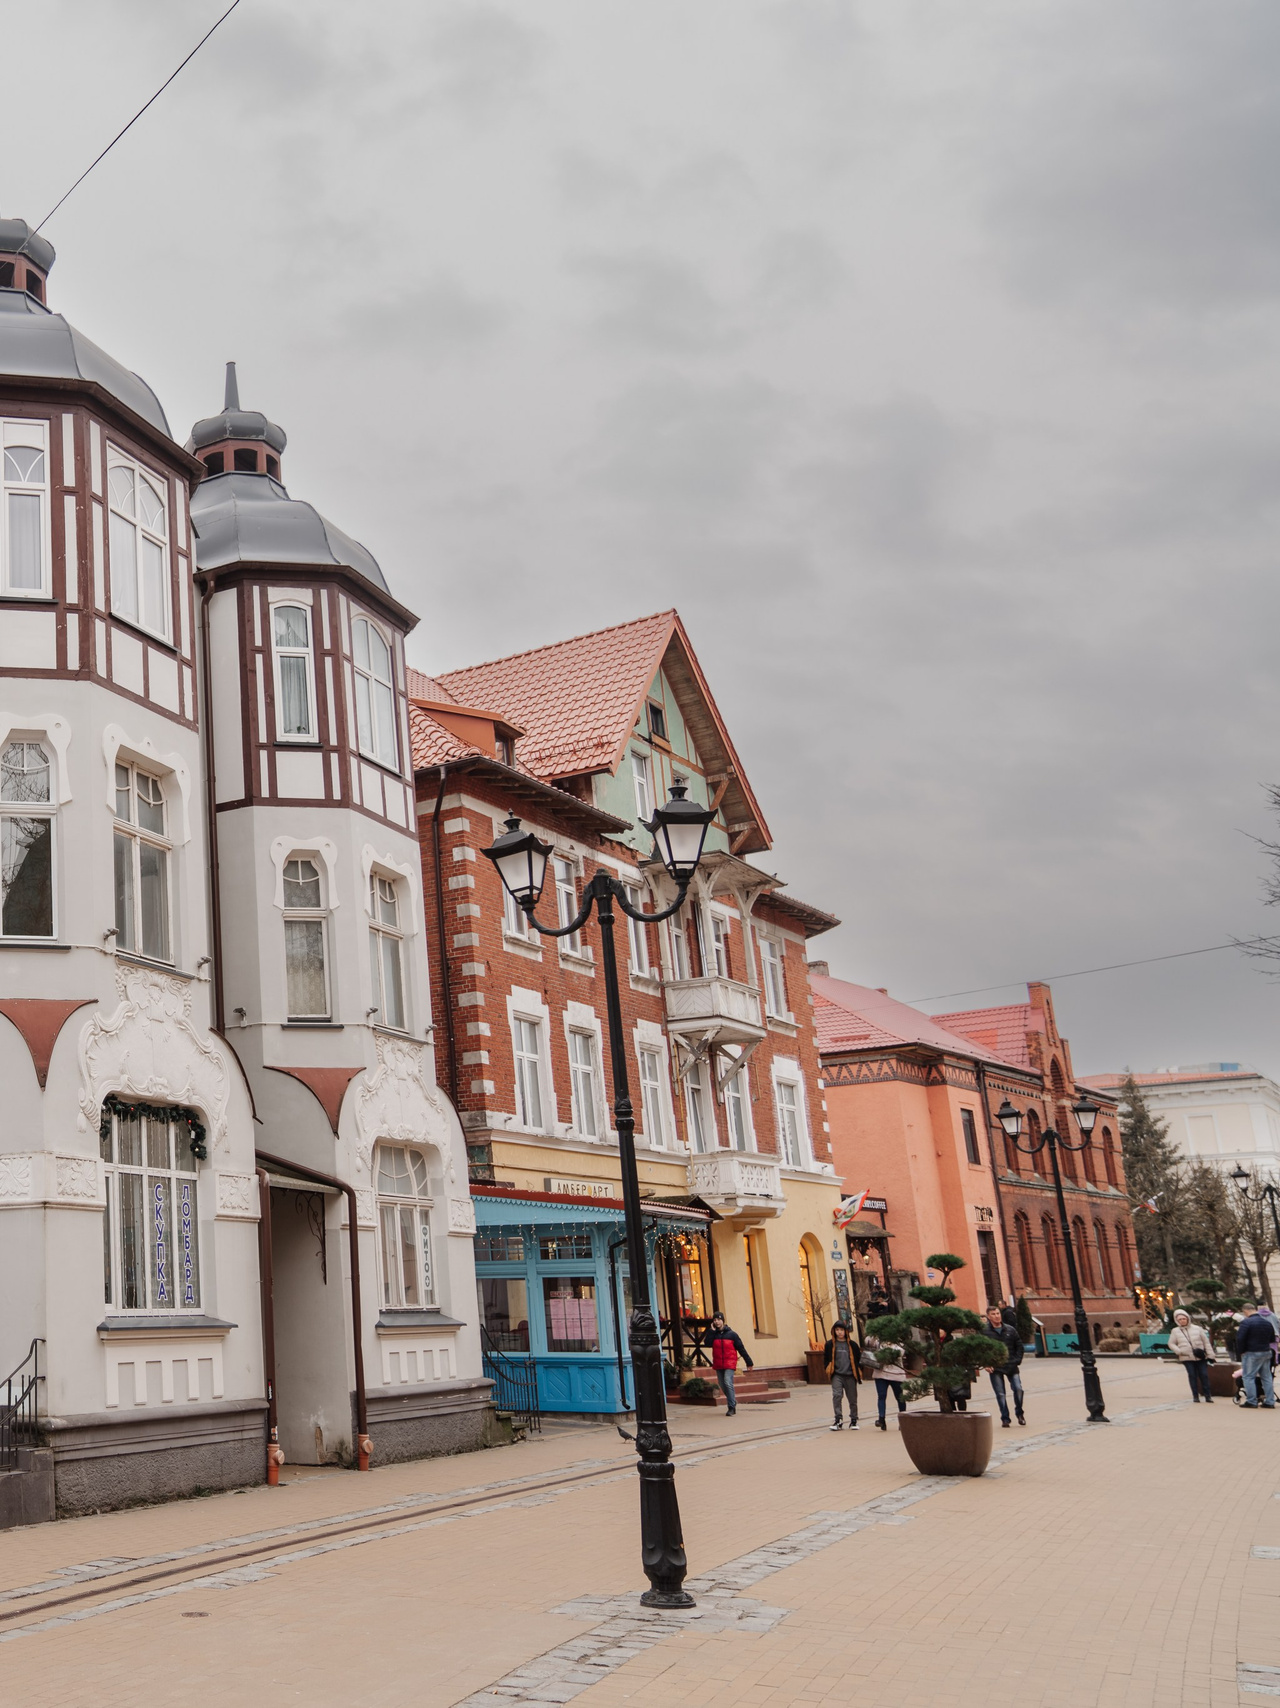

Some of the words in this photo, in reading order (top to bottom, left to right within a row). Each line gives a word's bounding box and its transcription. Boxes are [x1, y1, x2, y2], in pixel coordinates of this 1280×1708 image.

[154, 1184, 167, 1300] СКУПКА
[182, 1185, 194, 1303] ЛОМБАРД
[557, 1182, 587, 1196] АМБЕР
[593, 1185, 609, 1197] АРТ
